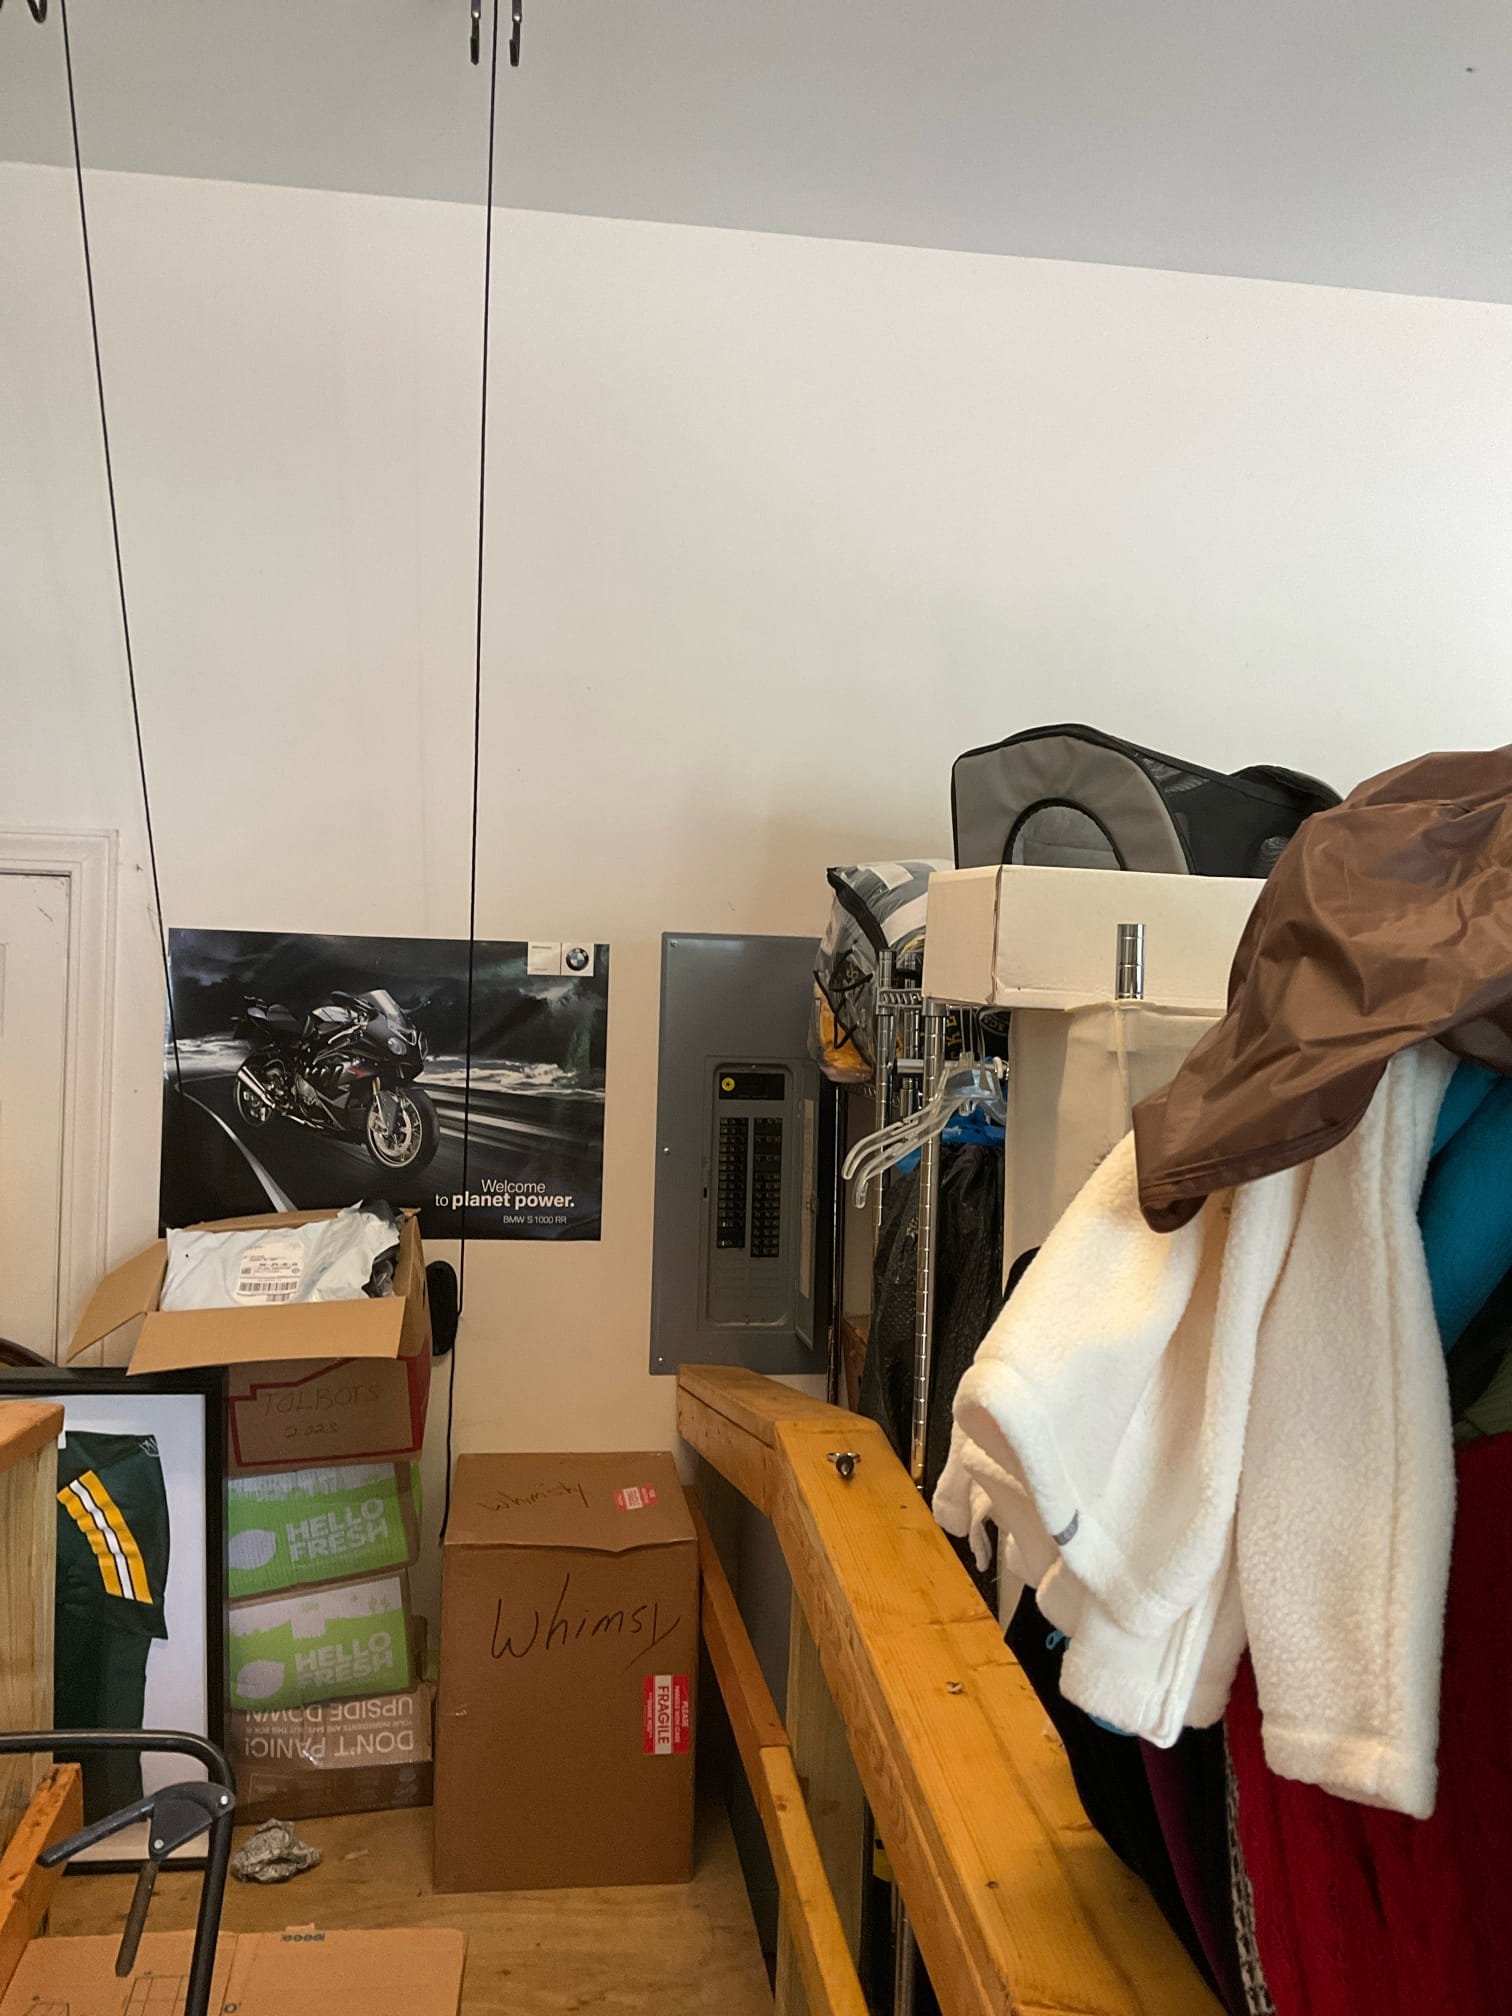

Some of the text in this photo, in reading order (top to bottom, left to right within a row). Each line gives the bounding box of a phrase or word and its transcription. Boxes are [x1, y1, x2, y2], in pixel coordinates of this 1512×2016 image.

[435, 1191, 575, 1210] to planet power.
[481, 1179, 546, 1193] Welcome
[503, 1215, 567, 1224] BMW S 1000 RR
[286, 1499, 384, 1542] HELLO
[290, 1519, 388, 1563] FRESH
[491, 1572, 681, 1671] Whimsy
[295, 1632, 391, 1672] HELLO
[299, 1650, 393, 1688] FRESH
[330, 1697, 413, 1721] UPSIDE
[657, 1685, 670, 1744] FRAGILE
[681, 1701, 689, 1728] PLEASE
[245, 1730, 414, 1759] DON'T PANIC!
